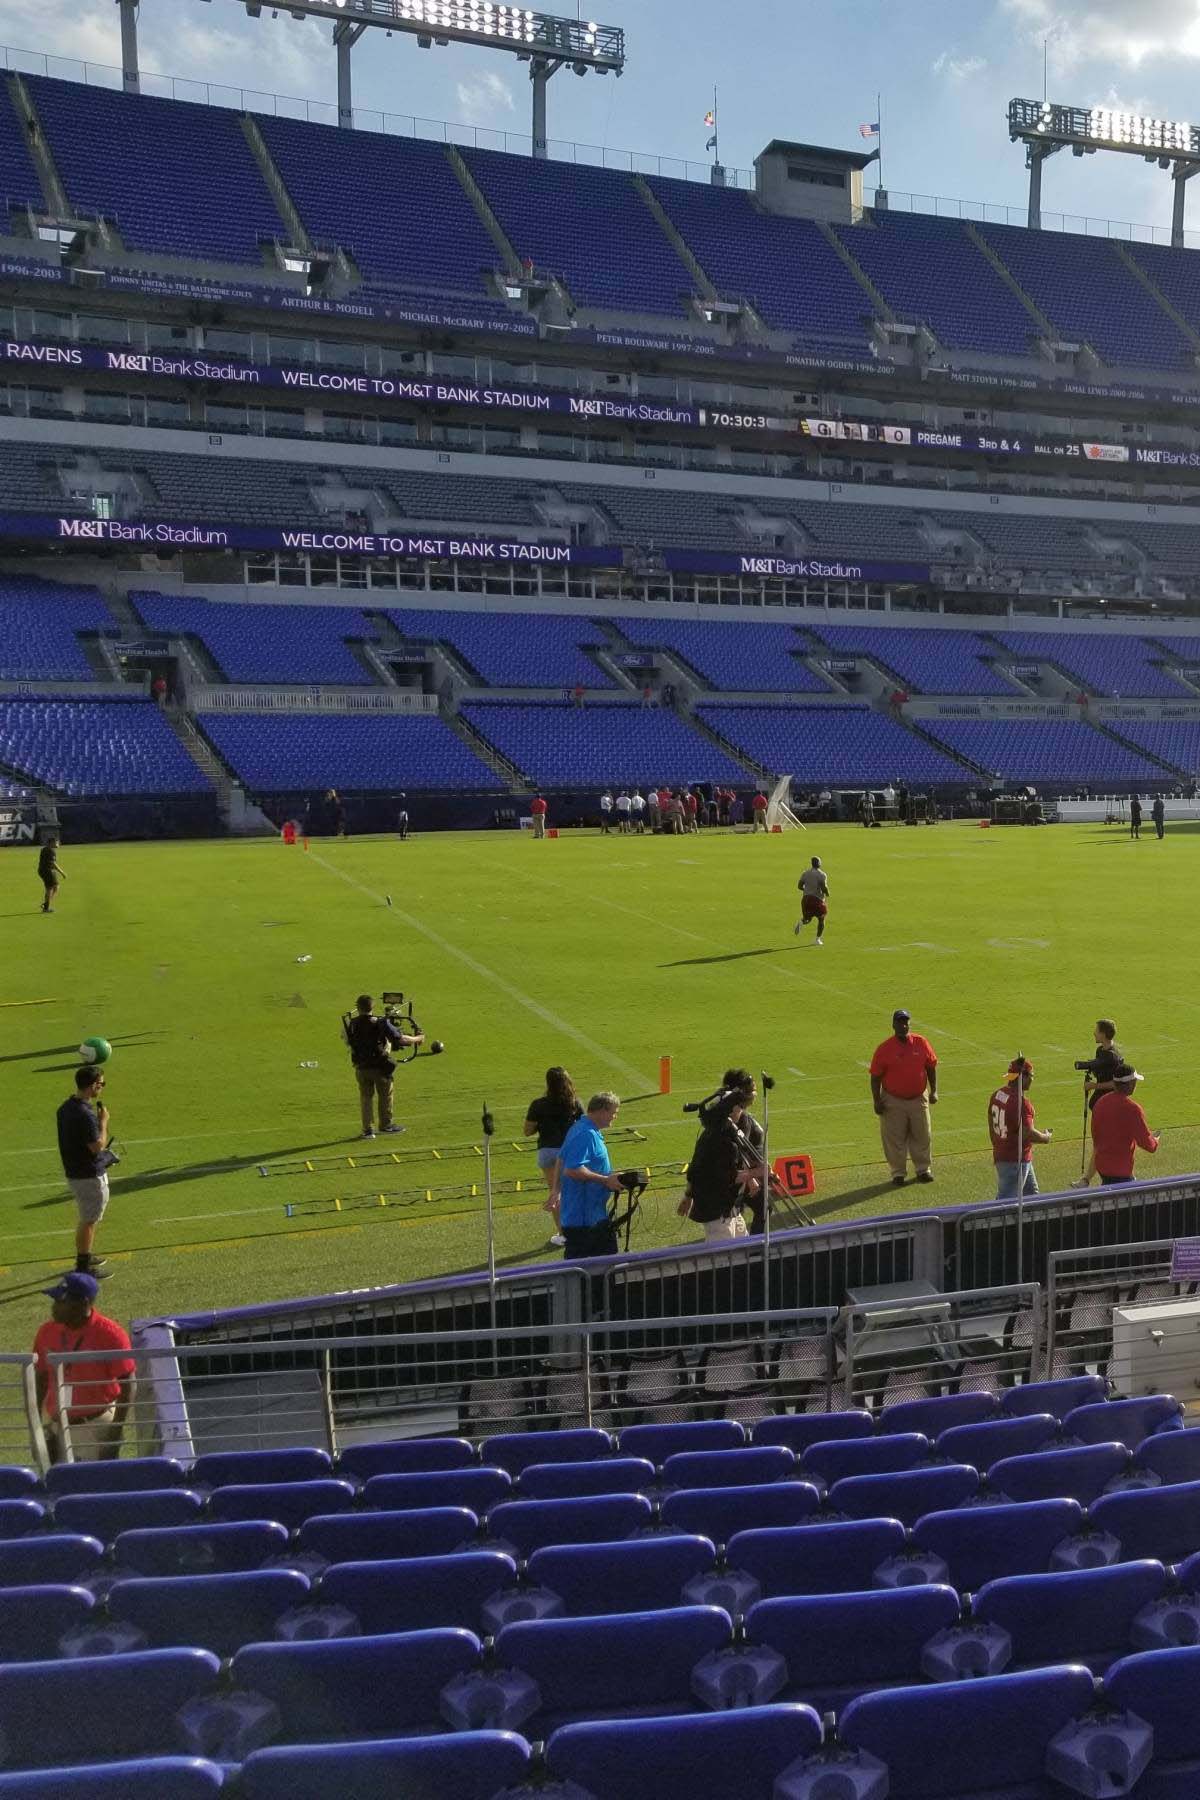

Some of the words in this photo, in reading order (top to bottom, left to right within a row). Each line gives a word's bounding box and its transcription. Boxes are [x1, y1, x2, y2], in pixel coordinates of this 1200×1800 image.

[1, 263, 62, 280] 1996-2003
[110, 275, 139, 286] JOHNNY
[175, 282, 190, 291] THE
[192, 285, 230, 296] BALTIMORE
[231, 289, 254, 298] COLTS
[282, 297, 321, 311] ARTHUR
[324, 302, 333, 312] B.
[336, 304, 375, 317] MODELL
[400, 311, 441, 325] MICHAEL
[488, 321, 535, 335] 1997-2002
[596, 333, 624, 345] PETER
[625, 337, 670, 350] BOULWARE
[7, 344, 83, 364] RAVENS
[785, 355, 826, 368] JONATHAN
[827, 359, 854, 371] OGDEN
[107, 352, 152, 372] M&T
[152, 357, 191, 376] Bank
[194, 361, 259, 383] Stadium
[951, 372, 970, 382] MATT
[281, 370, 368, 392] WELCOME
[371, 380, 394, 394] TO
[400, 383, 433, 398] M&T
[437, 386, 480, 403] BANK
[483, 391, 550, 409] STADIUM
[1064, 383, 1085, 394] JAMAL
[569, 398, 605, 415] M&T
[605, 402, 638, 420] Bank
[639, 404, 691, 424] Stadium
[712, 413, 771, 429] 70:30:3
[918, 432, 961, 447] PREGAME
[978, 438, 998, 450] 3RD
[1000, 440, 1010, 451] &
[1013, 441, 1021, 452] 4
[1034, 445, 1053, 455] BALL
[1054, 447, 1065, 456] ON
[1066, 445, 1080, 456] 25
[1136, 448, 1162, 463] M&T
[1163, 450, 1188, 465] Bank
[60, 519, 107, 538] M&T
[109, 522, 153, 540] Bank
[156, 524, 228, 545] Stadium
[282, 531, 374, 551] WELCOME
[379, 537, 404, 552] TO
[409, 539, 445, 554] M&T
[449, 541, 496, 557] BANK
[499, 544, 571, 561] STADIUM
[741, 557, 776, 574] M&T
[776, 559, 810, 575] Bank
[810, 561, 861, 578] Stadium
[784, 1159, 808, 1190] G
